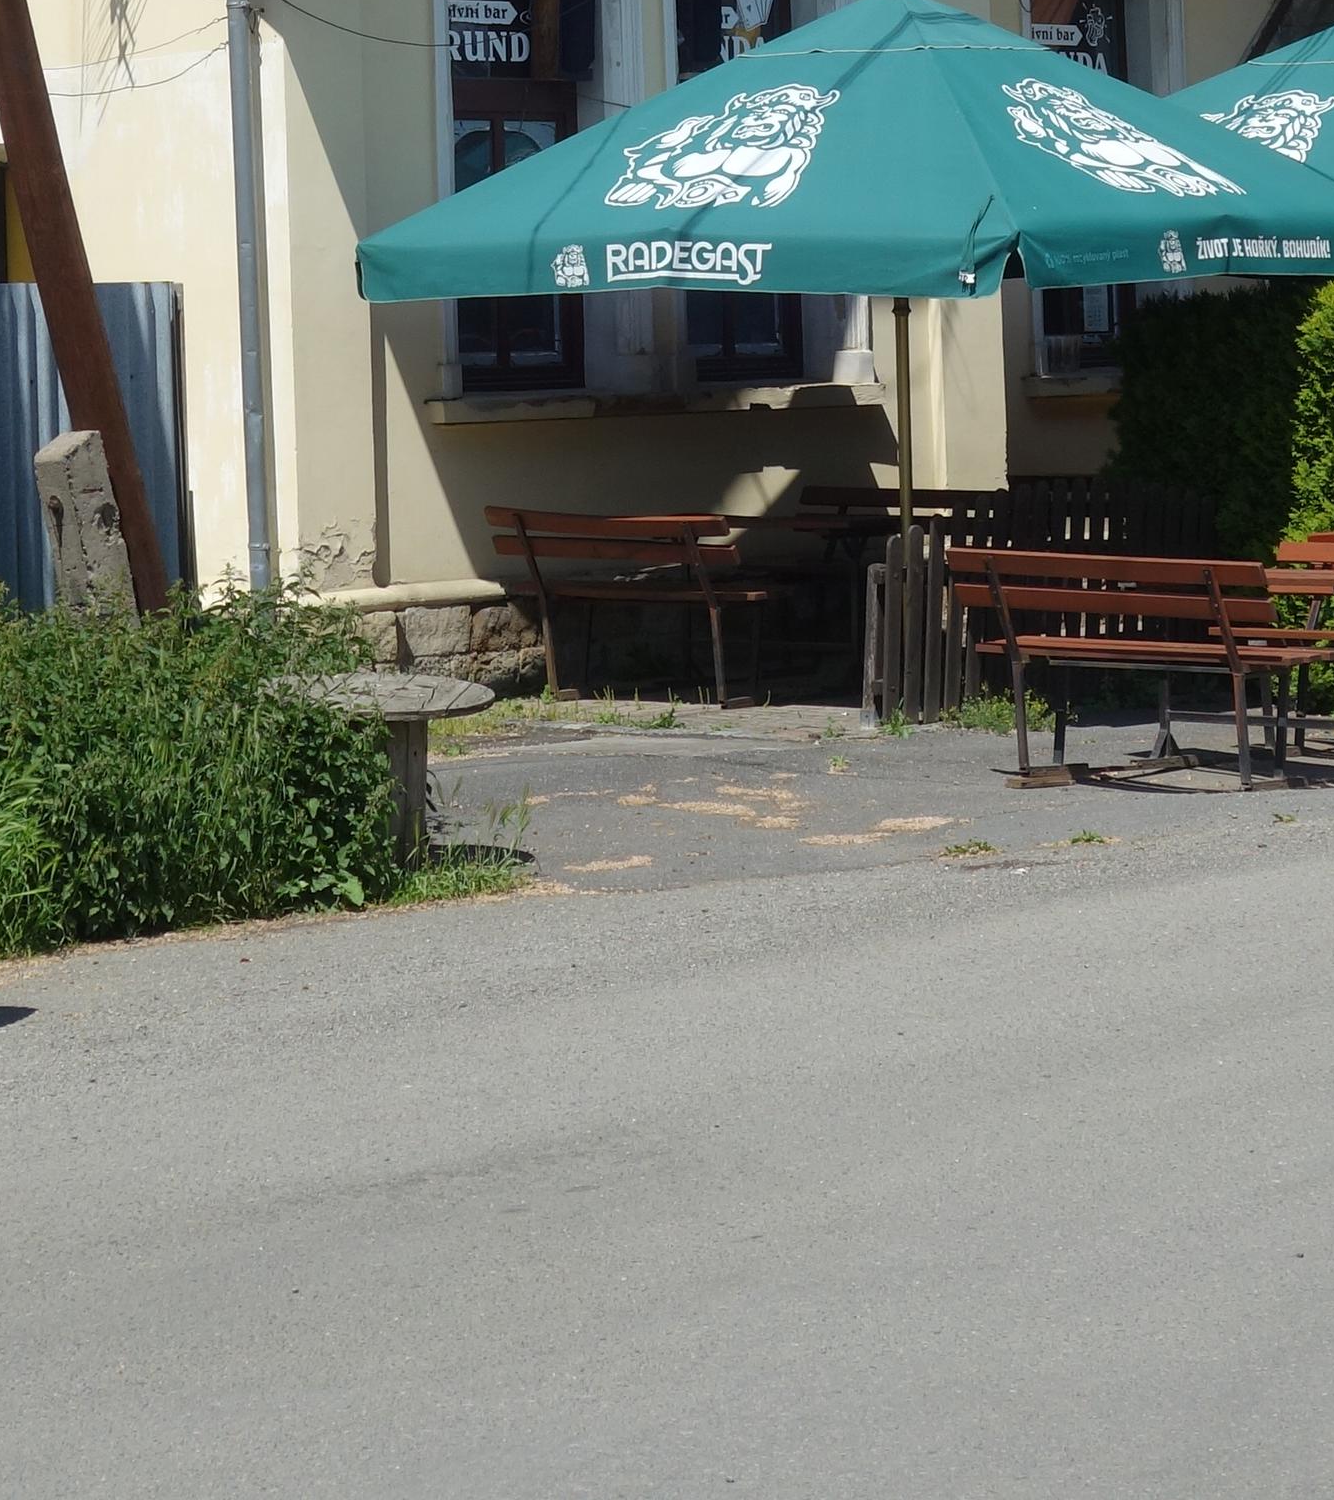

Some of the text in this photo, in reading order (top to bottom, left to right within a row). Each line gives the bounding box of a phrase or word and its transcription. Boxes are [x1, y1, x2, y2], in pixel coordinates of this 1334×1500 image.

[448, 2, 508, 20] ivní bar
[448, 30, 531, 62] RUND
[1031, 26, 1075, 41] ivní bar
[1196, 235, 1331, 260] ŽIVOT JE HOŘKÝ. BOHUDÍK!
[606, 240, 773, 286] RADEGAST
